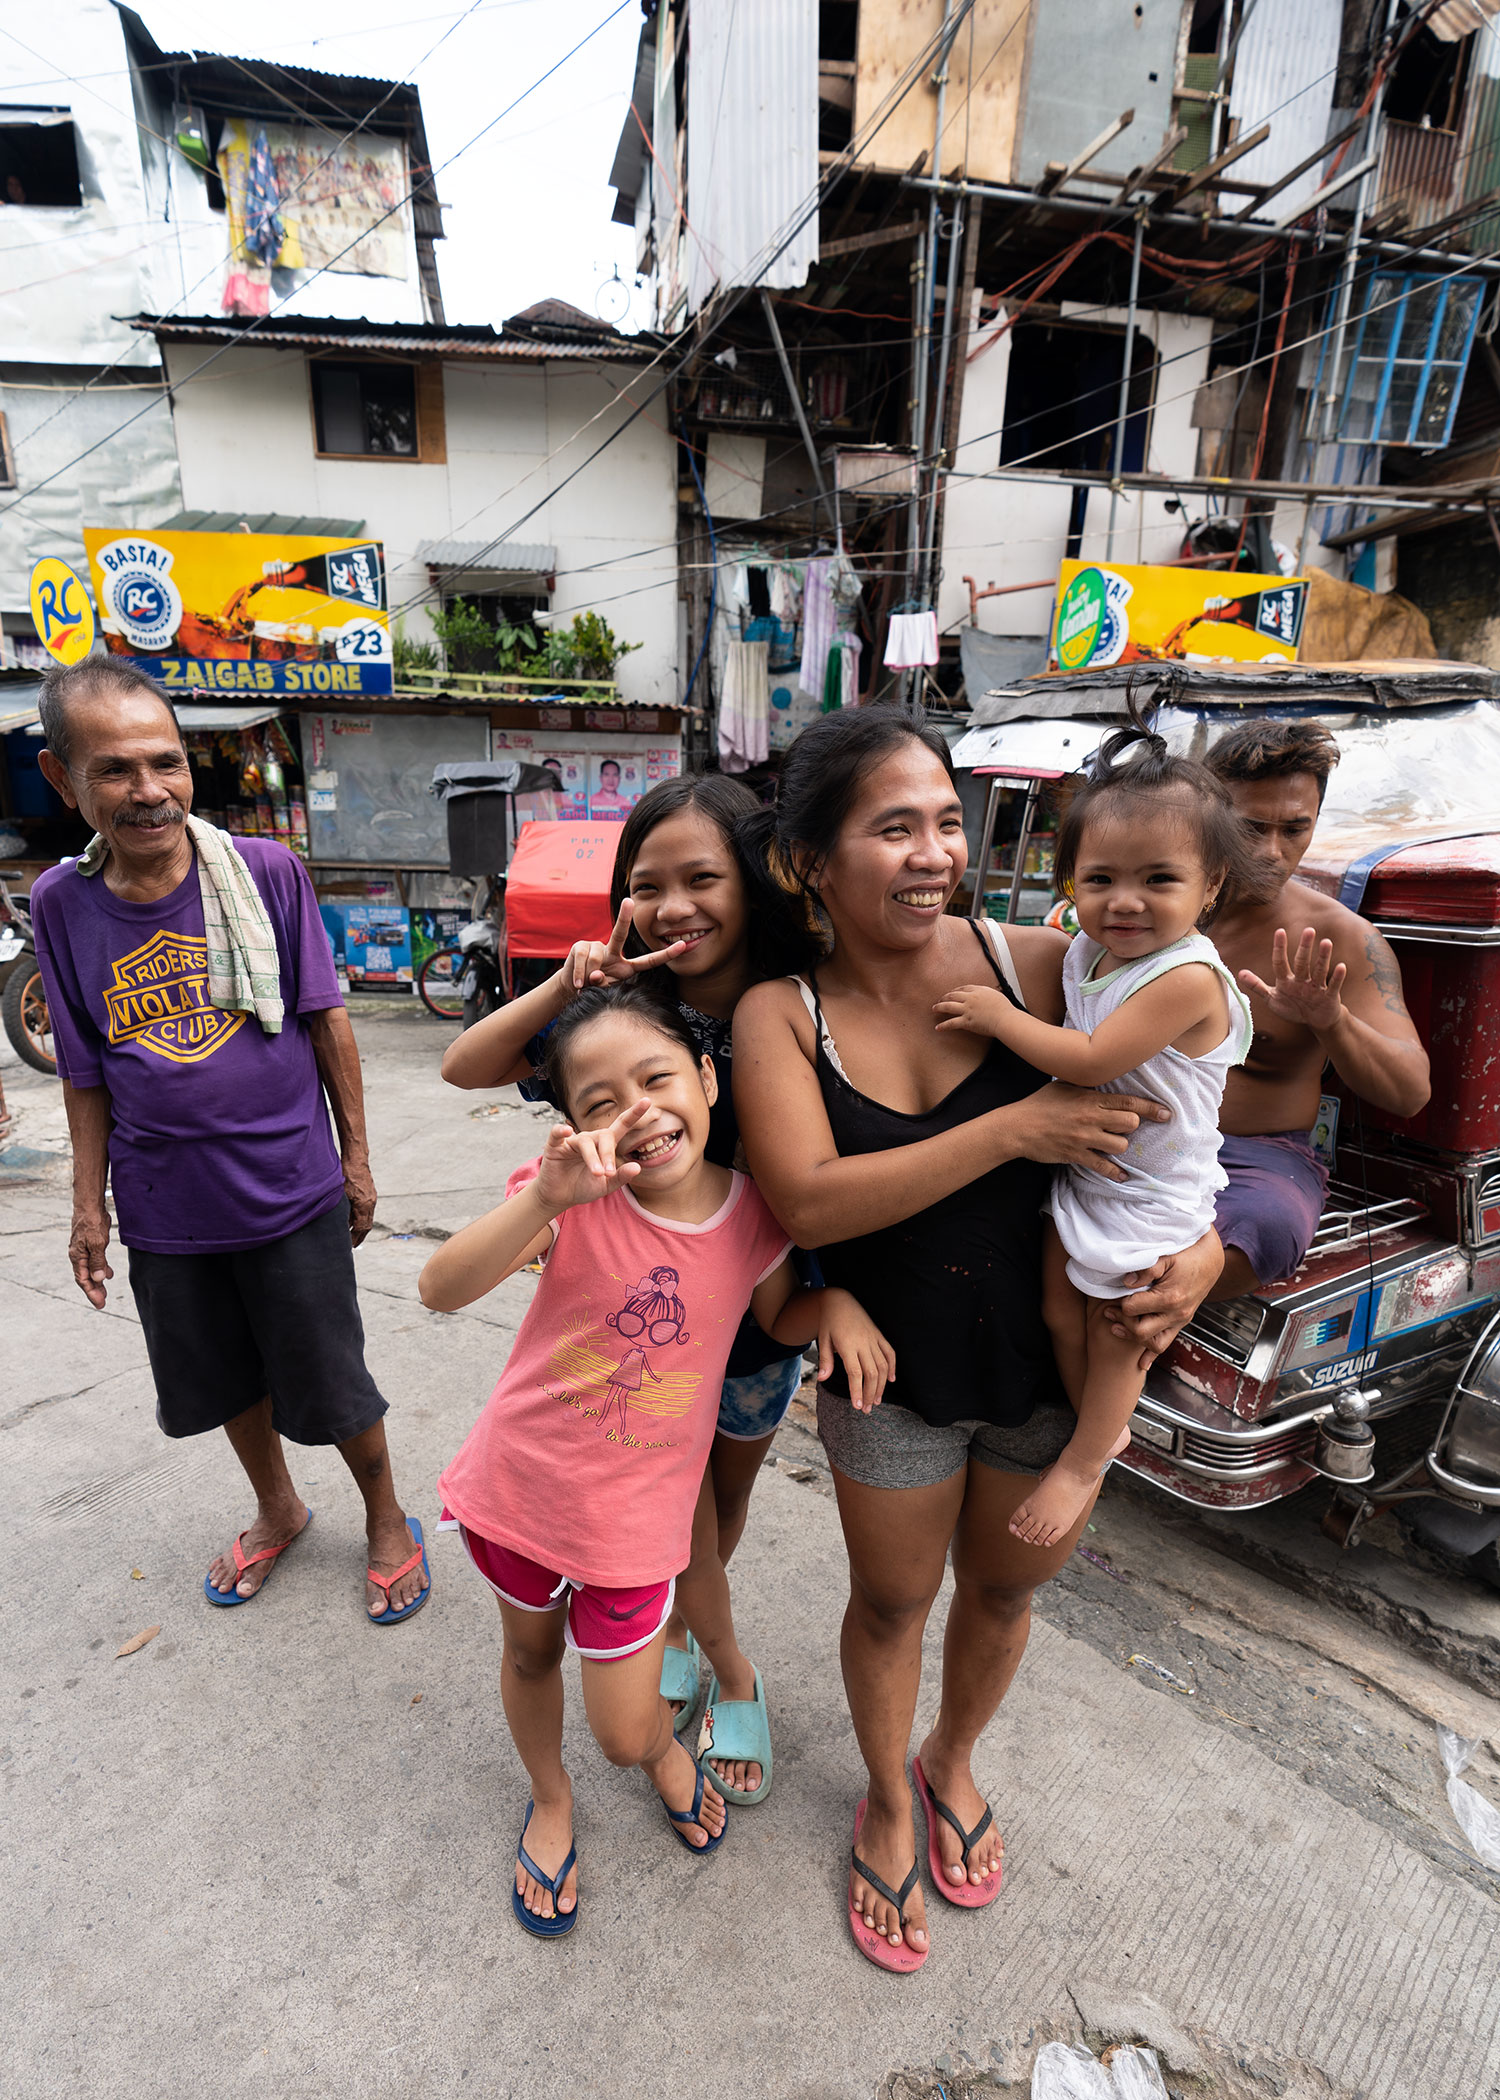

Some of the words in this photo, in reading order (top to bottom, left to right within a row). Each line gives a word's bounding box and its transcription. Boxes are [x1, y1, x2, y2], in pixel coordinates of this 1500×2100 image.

[104, 545, 167, 571] BASTA!
[331, 561, 354, 593] RC
[352, 553, 377, 604] MEGA
[38, 577, 82, 642] RC
[127, 588, 157, 612] RC
[1262, 599, 1278, 628] RC
[1280, 590, 1295, 640] MEGA
[161, 660, 274, 690] ZAIGAB
[284, 663, 362, 691] STORE
[135, 950, 207, 983] RIDERS
[160, 1014, 219, 1044] CLUB
[1313, 1350, 1378, 1388] SUZUKI
[622, 1434, 642, 1449] the
